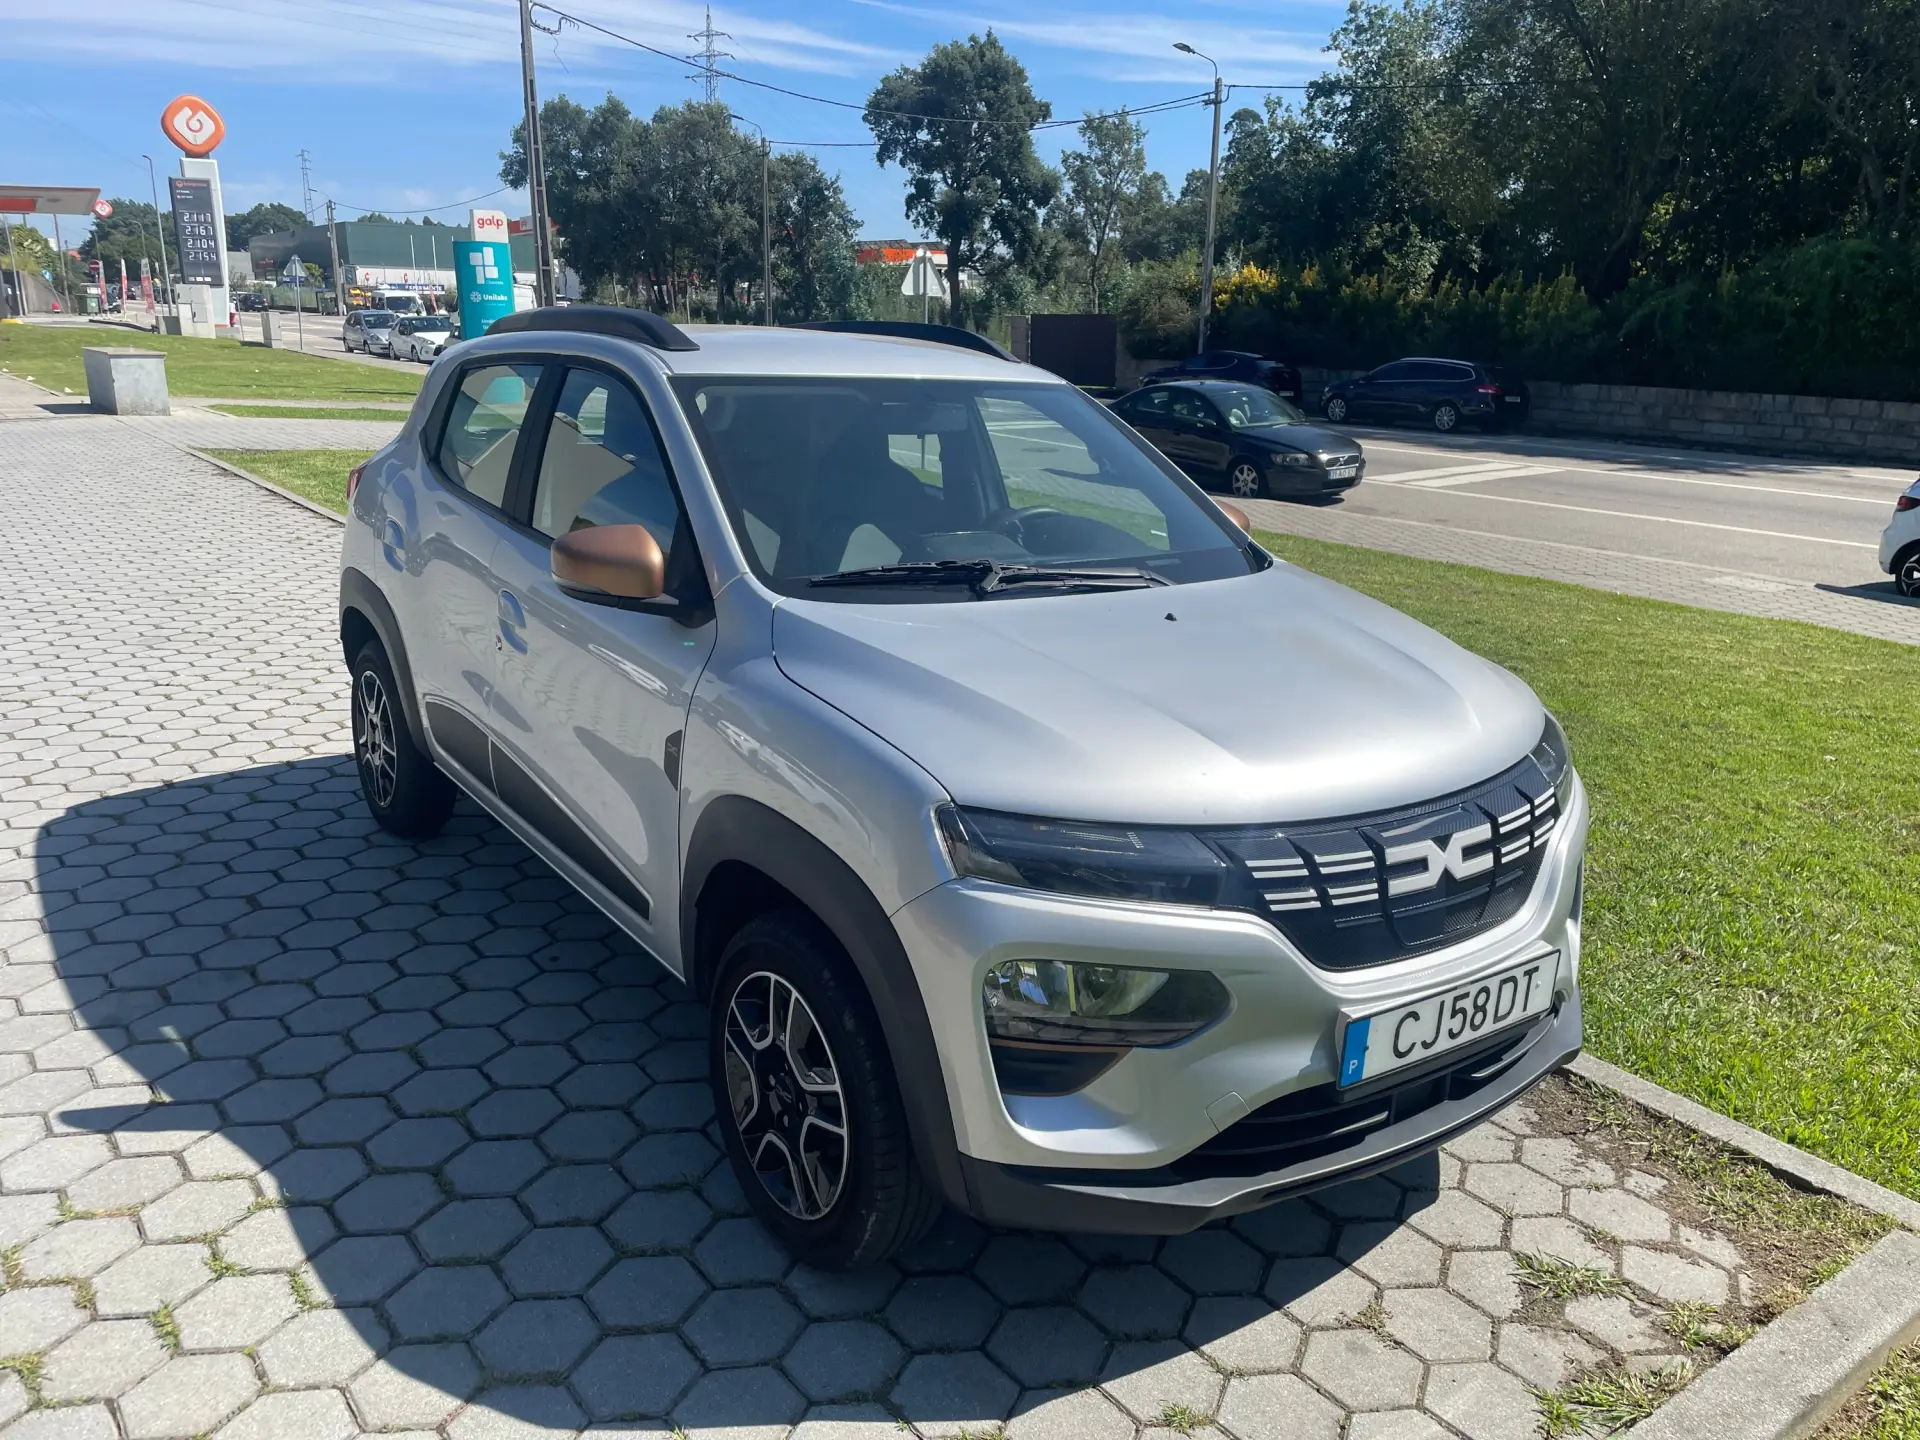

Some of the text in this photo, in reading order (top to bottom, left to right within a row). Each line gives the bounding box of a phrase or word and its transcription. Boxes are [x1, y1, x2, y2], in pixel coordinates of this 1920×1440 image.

[183, 212, 211, 222] 2.117
[477, 216, 504, 229] galp
[483, 293, 508, 301] Unilabs
[1392, 965, 1540, 1059] CJ58DT
[1349, 1058, 1358, 1075] P
